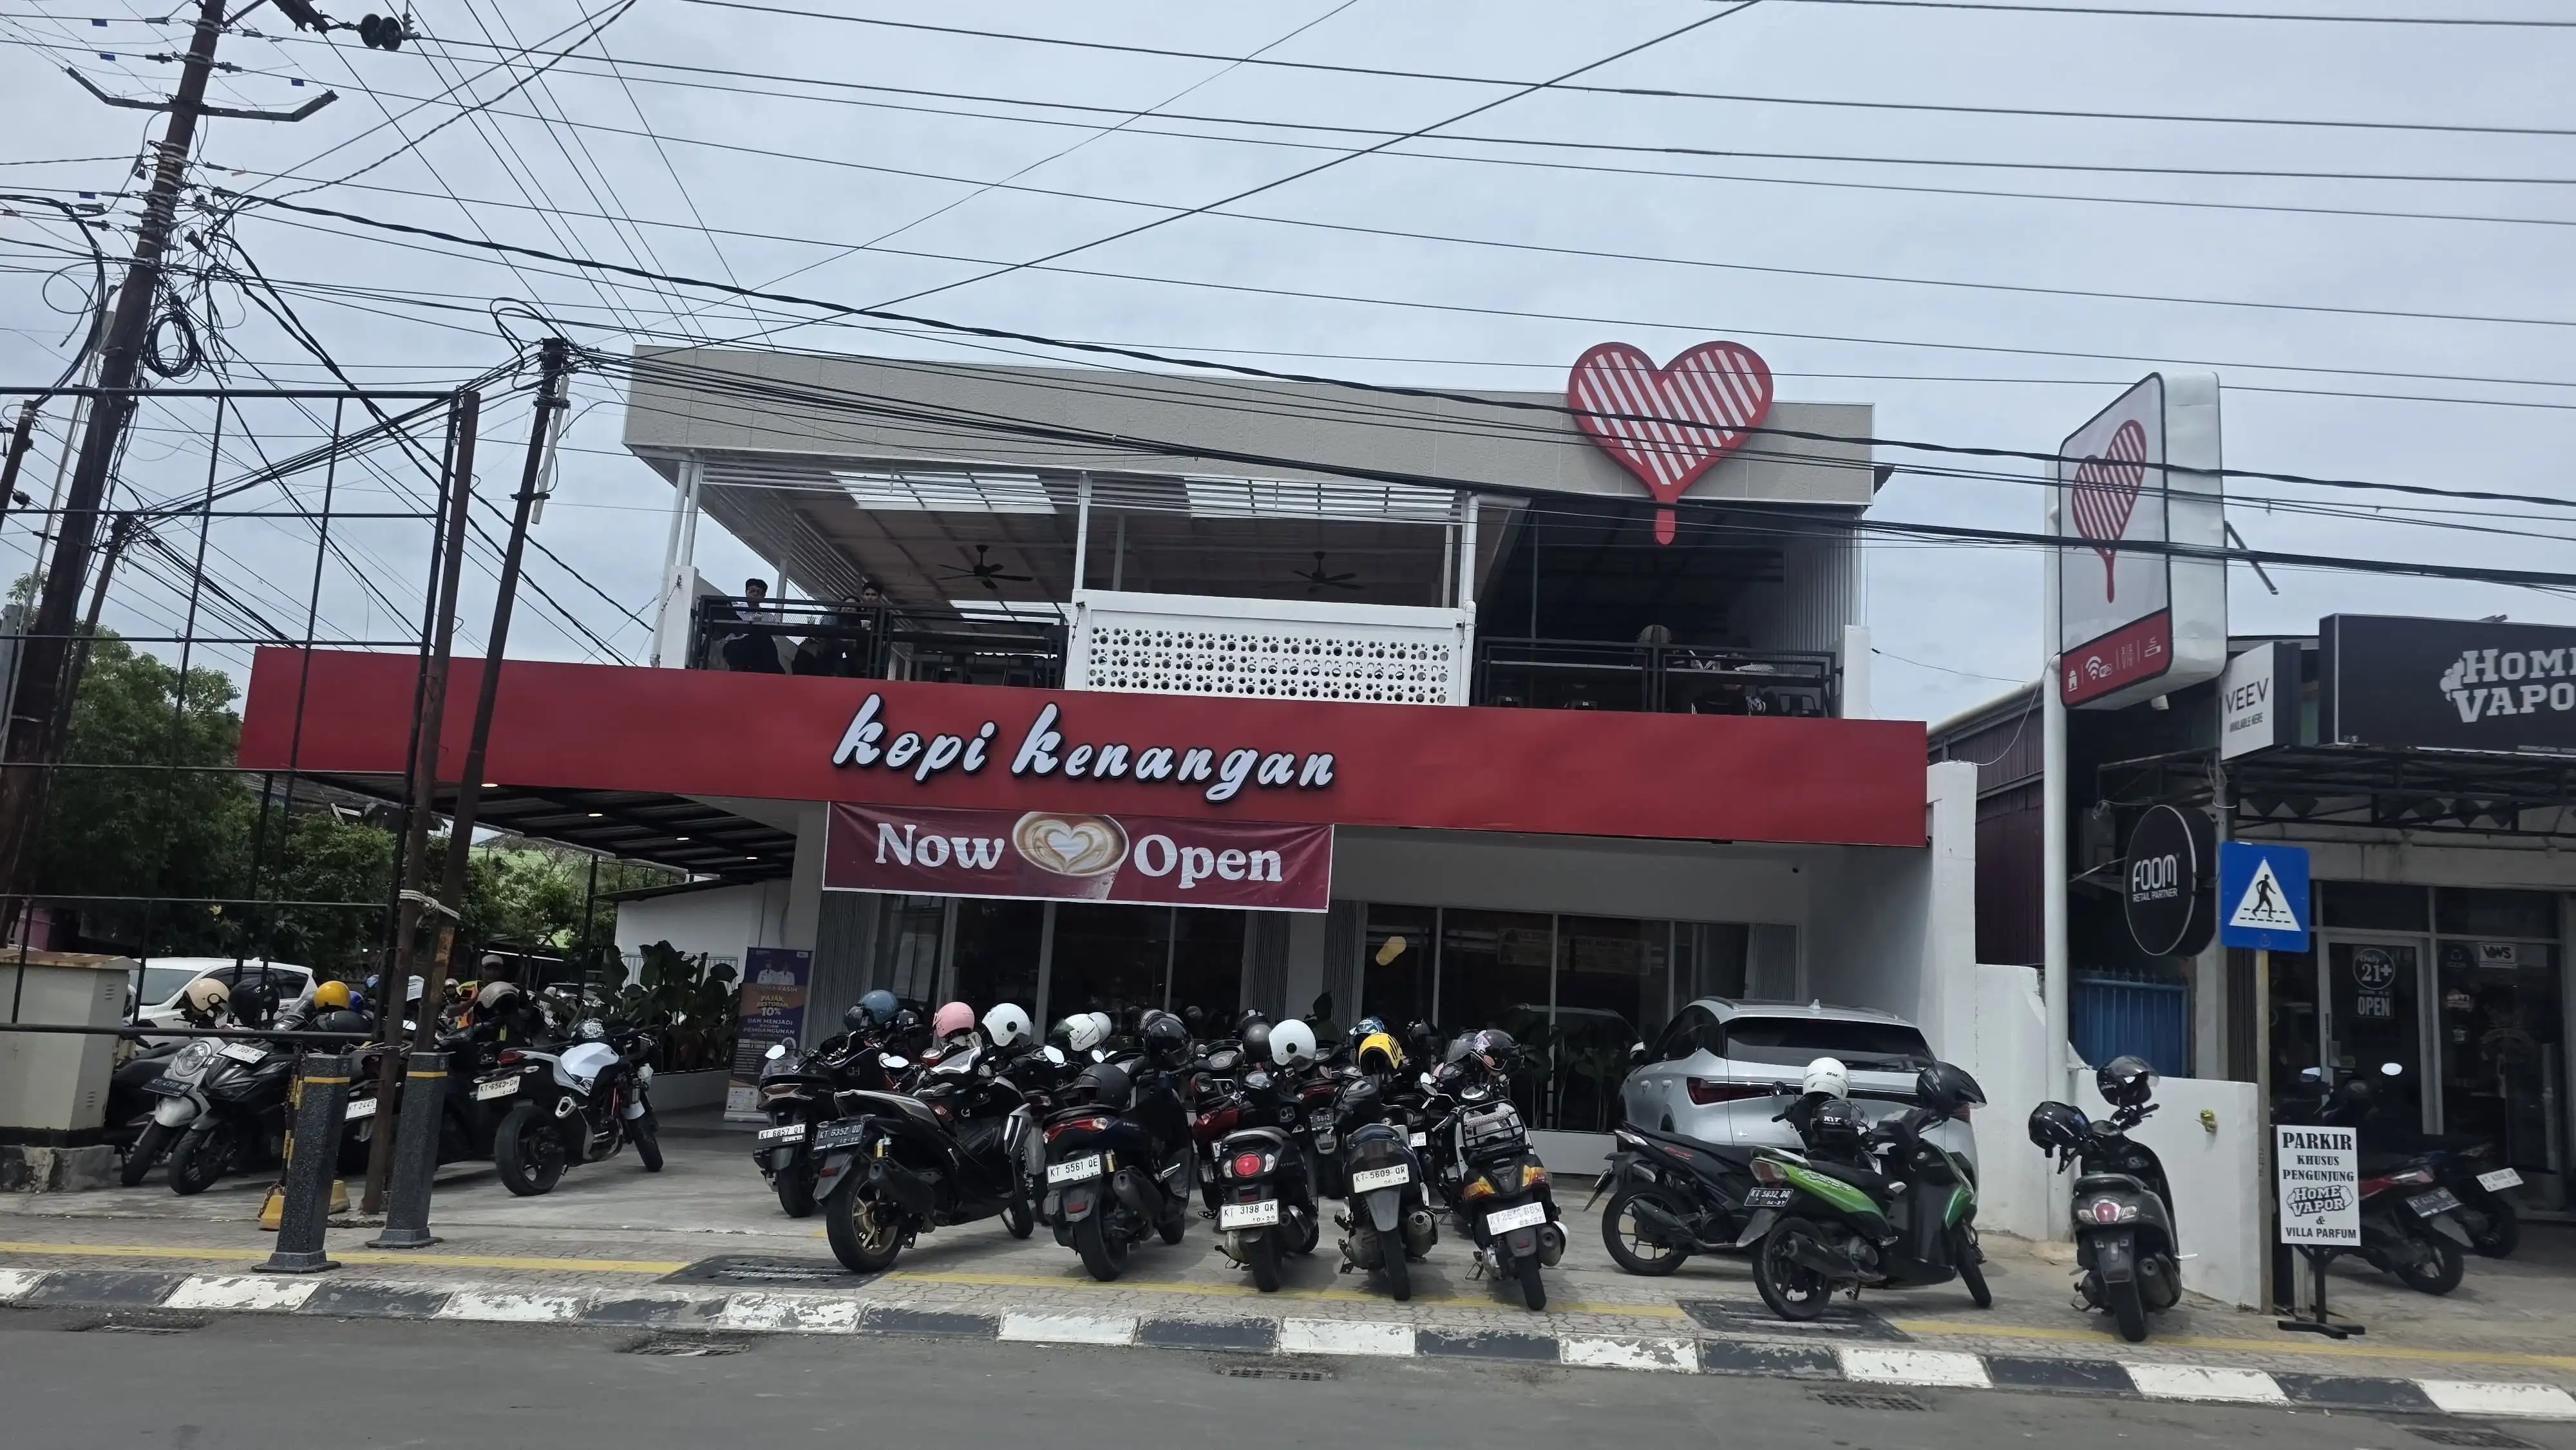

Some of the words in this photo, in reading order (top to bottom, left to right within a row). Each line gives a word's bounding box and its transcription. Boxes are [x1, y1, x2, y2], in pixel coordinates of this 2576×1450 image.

[2226, 677, 2269, 714] VEEV
[832, 692, 998, 783] kopi
[1012, 702, 1335, 803] kenangan
[876, 823, 1004, 871] Now
[1134, 834, 1282, 889] Open
[2133, 854, 2177, 892] FOOM
[2151, 887, 2177, 899] PARTNER
[2362, 963, 2392, 982] 21+
[761, 1006, 782, 1016] 10%
[2357, 996, 2391, 1017] OPEN
[348, 1102, 358, 1112] KT
[772, 1128, 790, 1137] 6857
[819, 1129, 829, 1139] KT
[2282, 1132, 2353, 1151] PARKIR
[2297, 1154, 2340, 1166] KHUSUS
[1050, 1167, 1059, 1177] KT
[1065, 1161, 1084, 1173] 5561
[1356, 1174, 1365, 1183] KT
[1370, 1169, 1390, 1179] 5609
[2282, 1169, 2354, 1182] PENGUNJUNG
[2294, 1185, 2340, 1201] HOME
[1224, 1207, 1234, 1217] KT
[1240, 1205, 1260, 1214] 3198
[2291, 1198, 2346, 1217] VAPOR
[2316, 1216, 2325, 1225] &
[2286, 1227, 2313, 1238] VILLA
[2316, 1228, 2357, 1239] PARFUM
